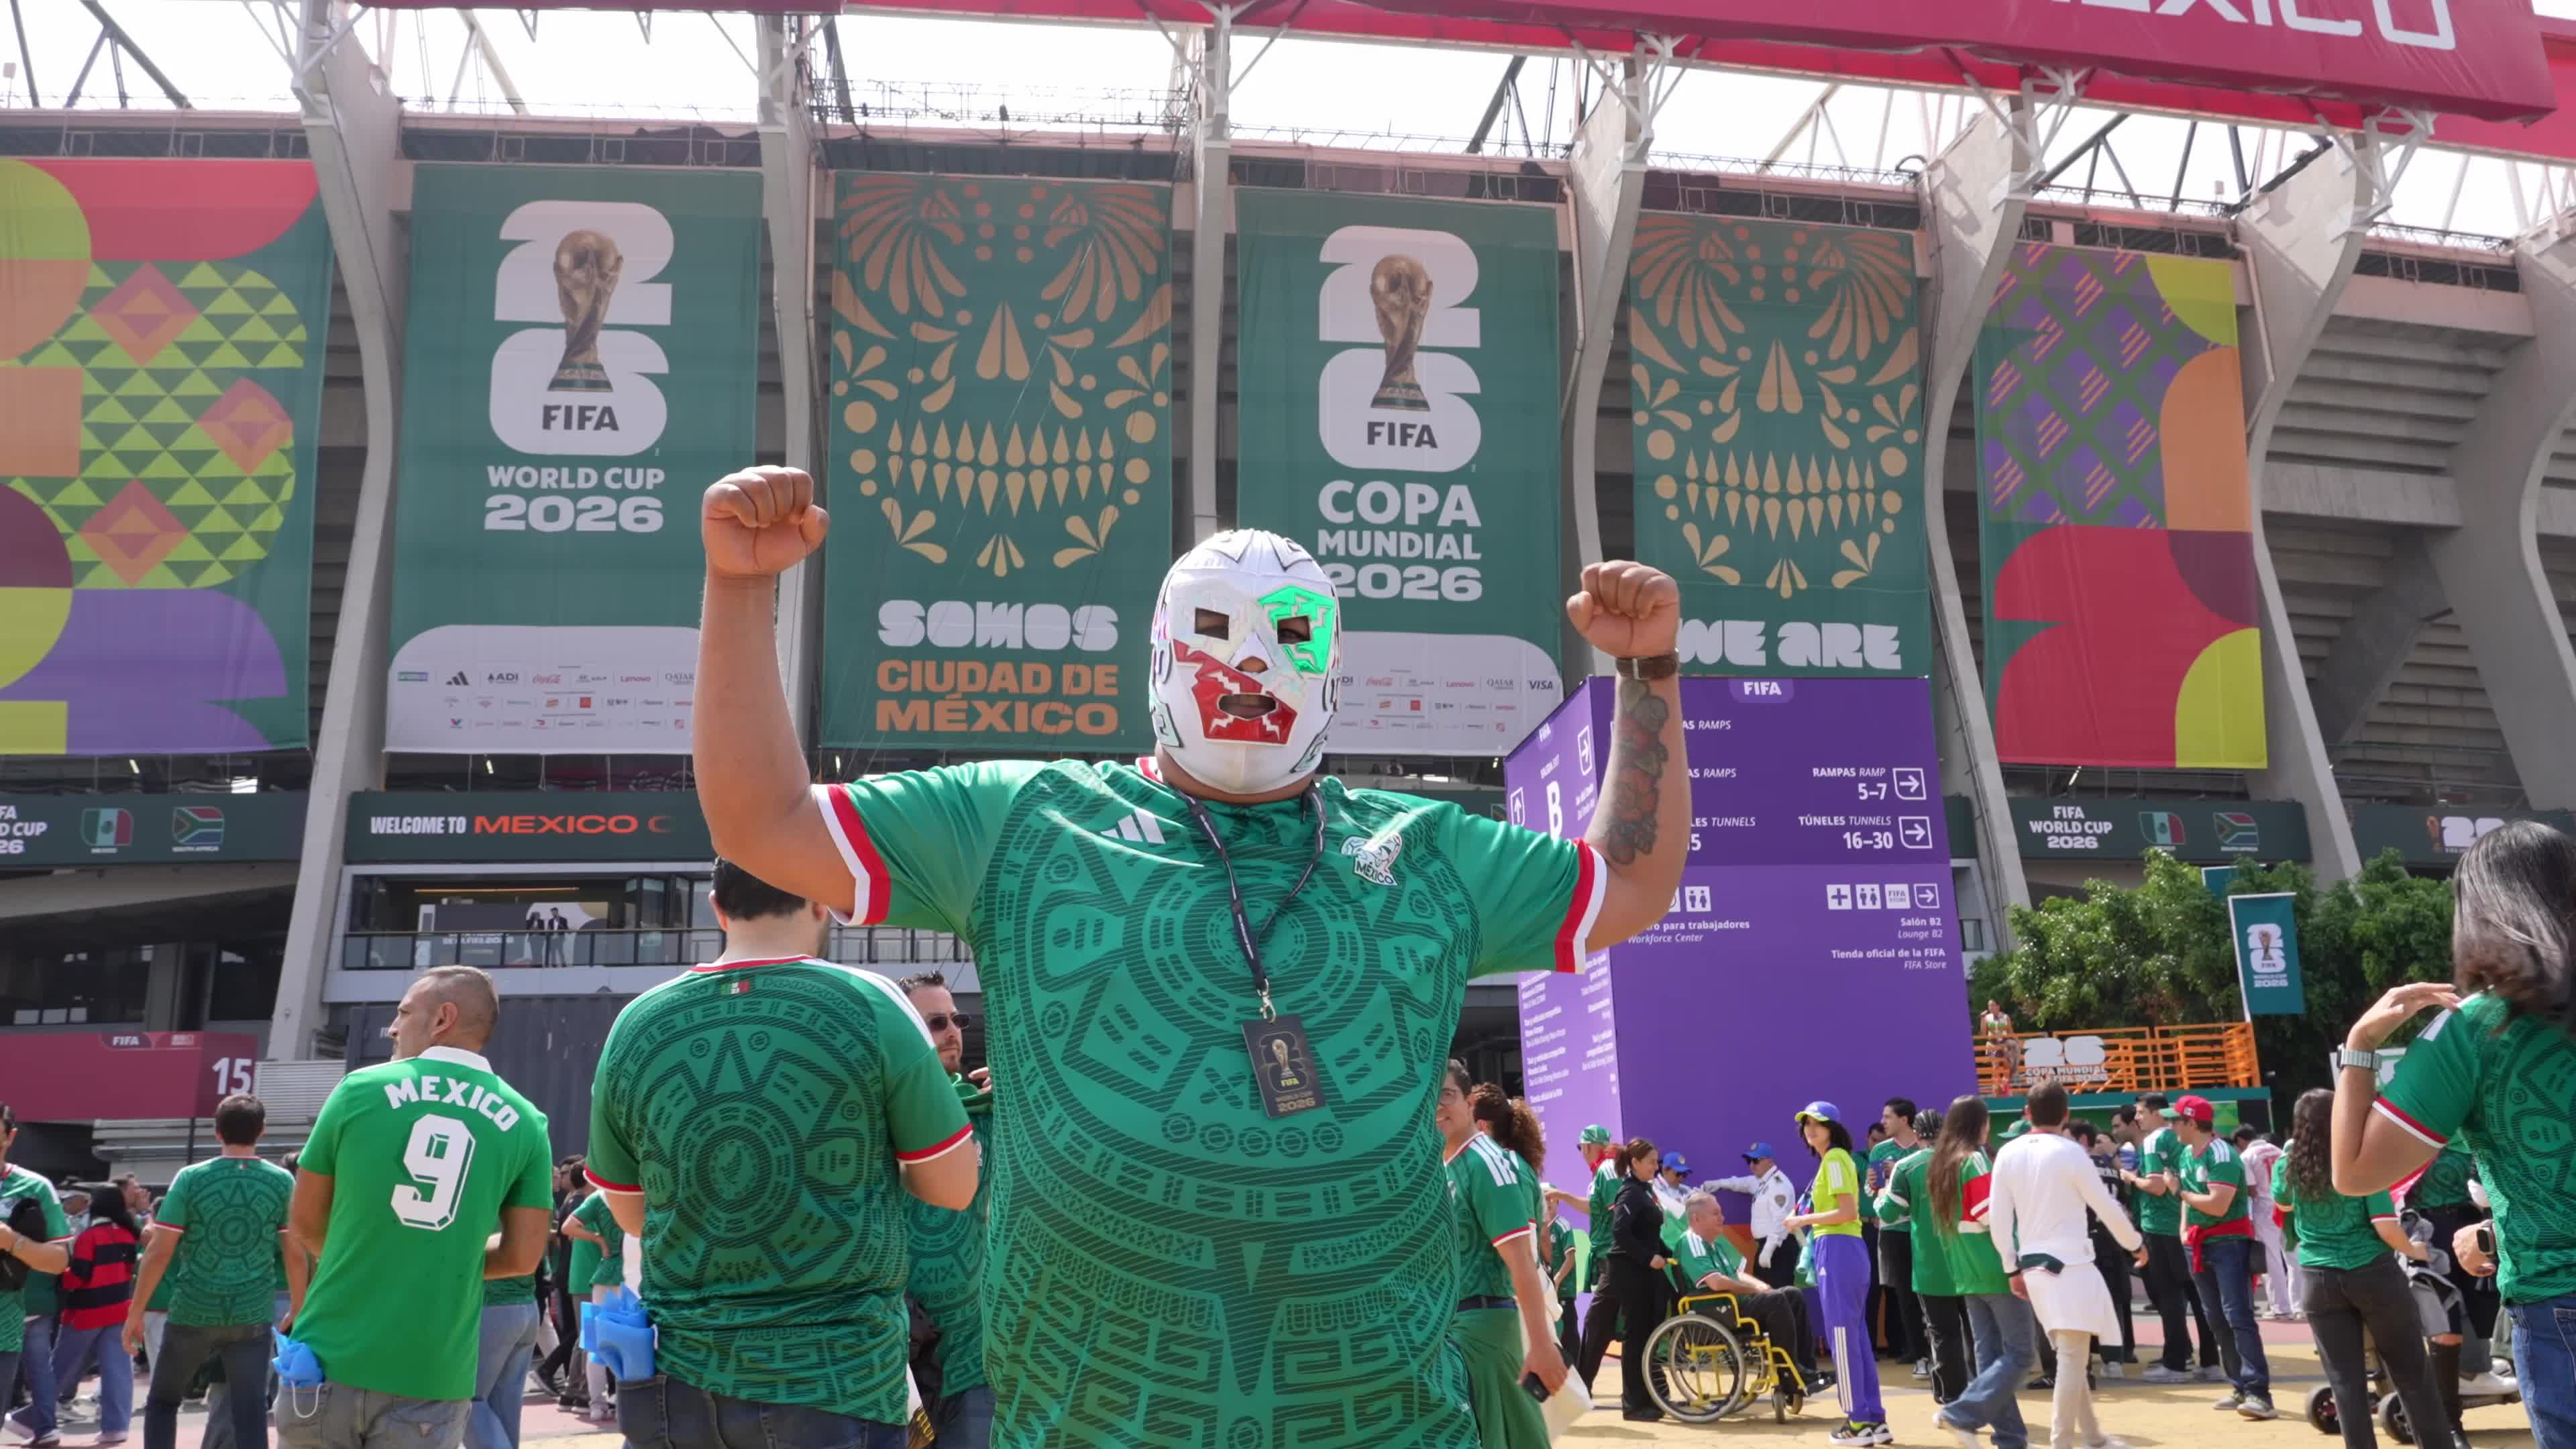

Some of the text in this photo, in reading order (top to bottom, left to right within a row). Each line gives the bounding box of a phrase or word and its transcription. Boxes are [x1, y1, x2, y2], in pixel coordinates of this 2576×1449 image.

[542, 405, 619, 431] FIFA
[1367, 421, 1438, 448] FIFA
[487, 466, 665, 490] WORLD CUP
[1318, 480, 1481, 527] COPA
[484, 494, 663, 532] 2026
[1318, 530, 1482, 560] MUNDIAL
[1325, 563, 1483, 602] 2026
[878, 600, 1118, 651] SOMOS
[1678, 619, 1902, 670] WE ARE
[876, 660, 1119, 696] CIUDAD DE
[1529, 680, 1554, 690] VISA
[1744, 682, 1782, 696] FIFA
[875, 692, 1118, 735] MÉXICO
[1698, 720, 1731, 730] RAMPS
[1703, 768, 1737, 778] RAMPS
[1813, 767, 1886, 777] RAMPAS RAMP
[2053, 806, 2085, 819] FIFA
[370, 816, 445, 835] WELCOME
[448, 816, 466, 834] TO
[474, 815, 638, 834] MEXICO
[1711, 816, 1756, 827] TUNNELS
[1798, 814, 1892, 826] TÚNELES TUNNELS
[12, 822, 48, 837] CUP
[2029, 821, 2112, 835] WORLD CUP
[2047, 836, 2099, 849] 2026
[1664, 922, 1685, 932] para
[1688, 920, 1750, 931] trabajadores
[1900, 918, 1941, 926] Salón B2
[1675, 934, 1703, 943] Center
[1898, 930, 1943, 940] Lounge B2
[1831, 948, 1945, 959] Tienda oficial de la FIFA
[1904, 961, 1946, 969] FIFA Store
[113, 1036, 140, 1046] FIFA
[212, 1058, 252, 1095] 15
[384, 1076, 519, 1132] MEXICO
[390, 1114, 476, 1231] 9
